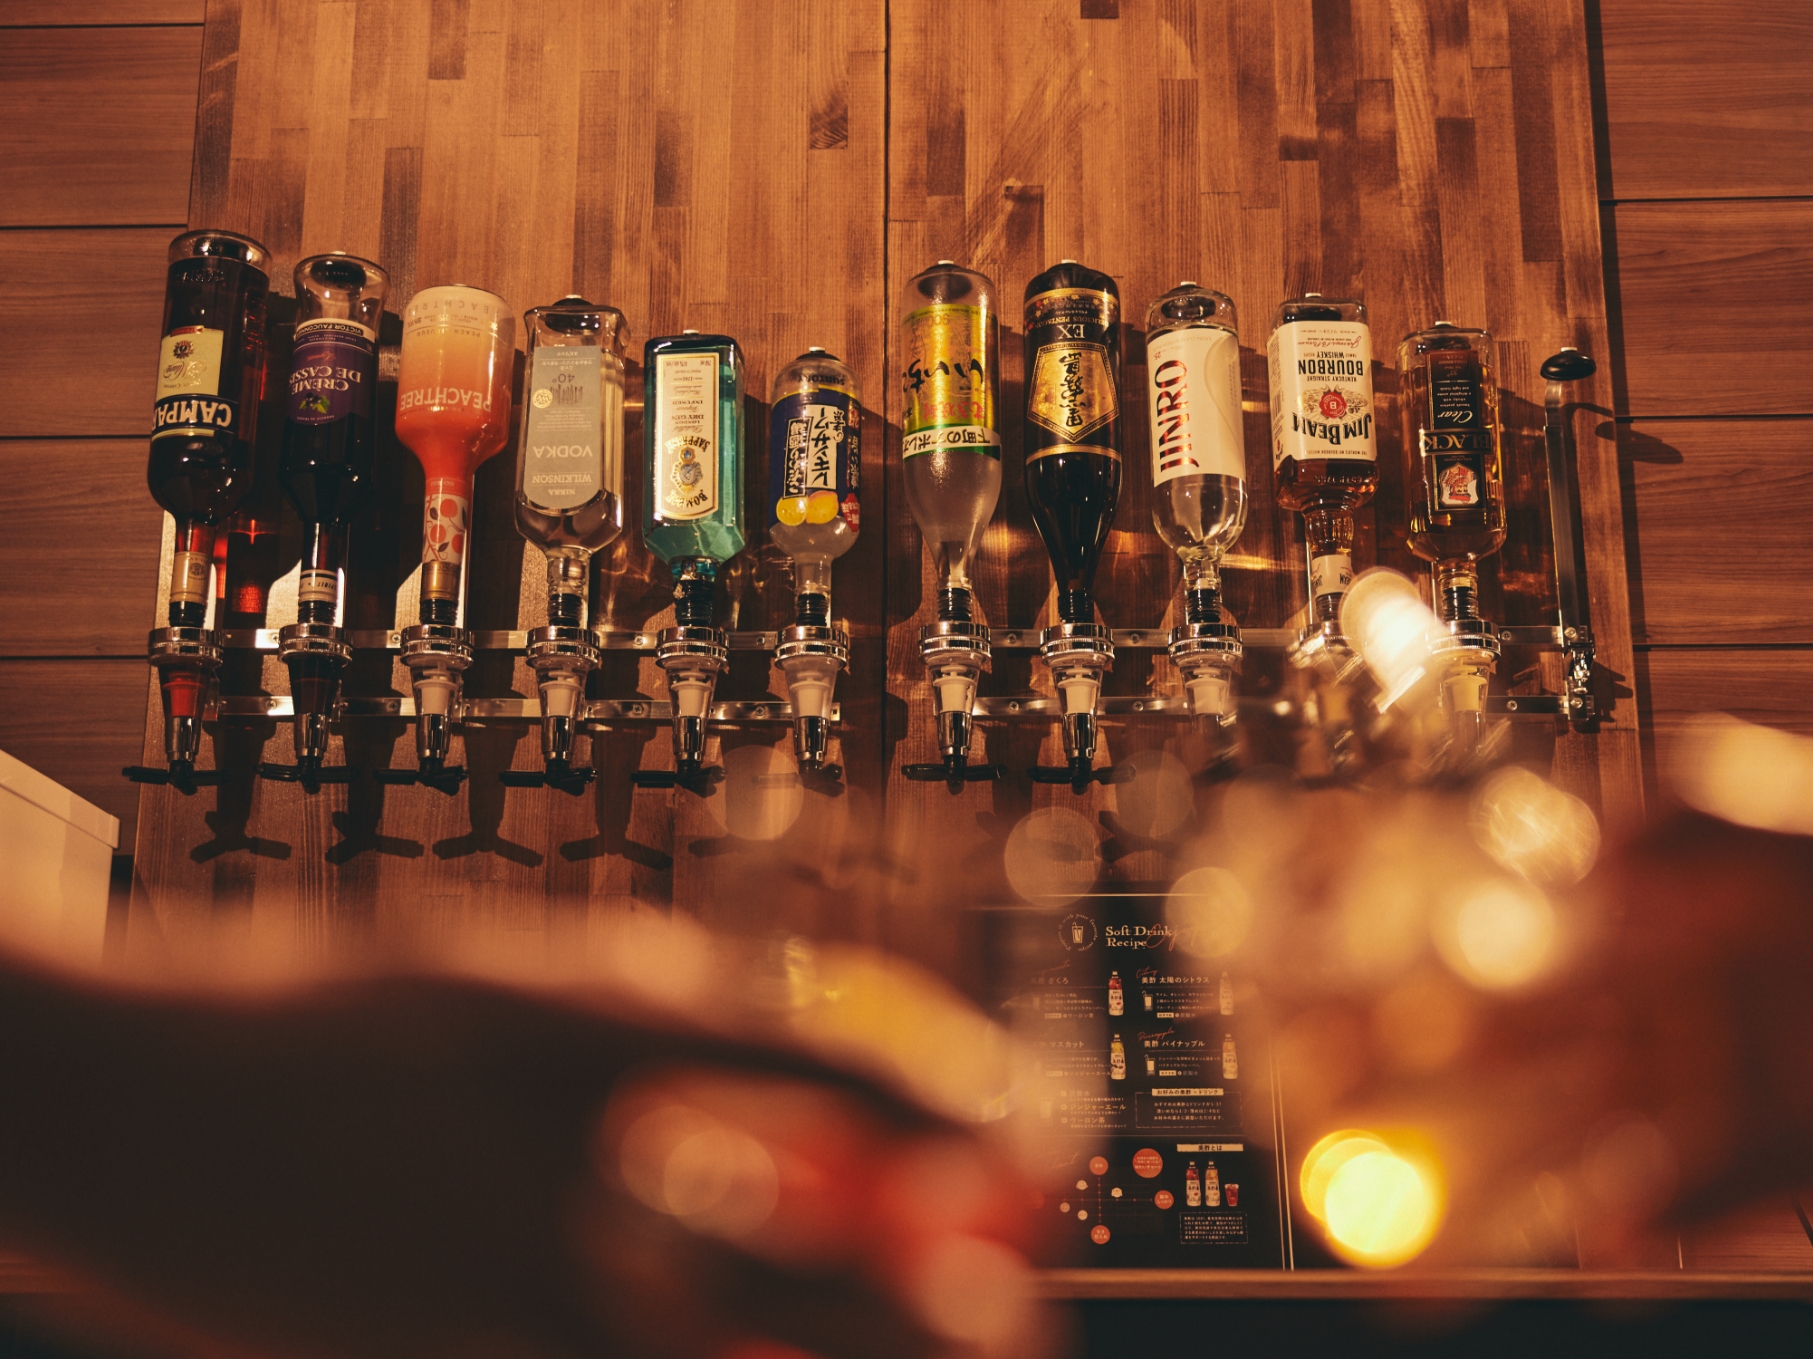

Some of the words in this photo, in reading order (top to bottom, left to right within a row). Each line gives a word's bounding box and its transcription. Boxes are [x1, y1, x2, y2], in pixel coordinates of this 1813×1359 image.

[335, 324, 362, 335] VICTOR
[453, 329, 481, 338] PEACH
[1055, 323, 1086, 340] EX
[336, 367, 361, 383] DE
[1298, 359, 1364, 376] BOURBON
[291, 378, 349, 395] CRÈME
[1059, 351, 1087, 428] 黒霧島
[400, 388, 491, 412] PEACHTREE
[1330, 401, 1337, 409] B
[1155, 360, 1200, 473] JINRO
[1437, 410, 1473, 424] Clear
[1292, 412, 1342, 446] BEAM
[1343, 415, 1373, 440] JIM
[811, 407, 830, 487] レモンサワー
[1425, 434, 1491, 450] BLACK
[533, 445, 593, 458] VODKA
[532, 474, 592, 484] WILKINSON
[1106, 925, 1131, 936] Soft
[1106, 937, 1147, 950] Recipe
[1159, 976, 1210, 984] 太陽のシトラス
[1162, 1040, 1205, 1048] パイナップル
[1070, 1116, 1106, 1124] ウーロン茶
